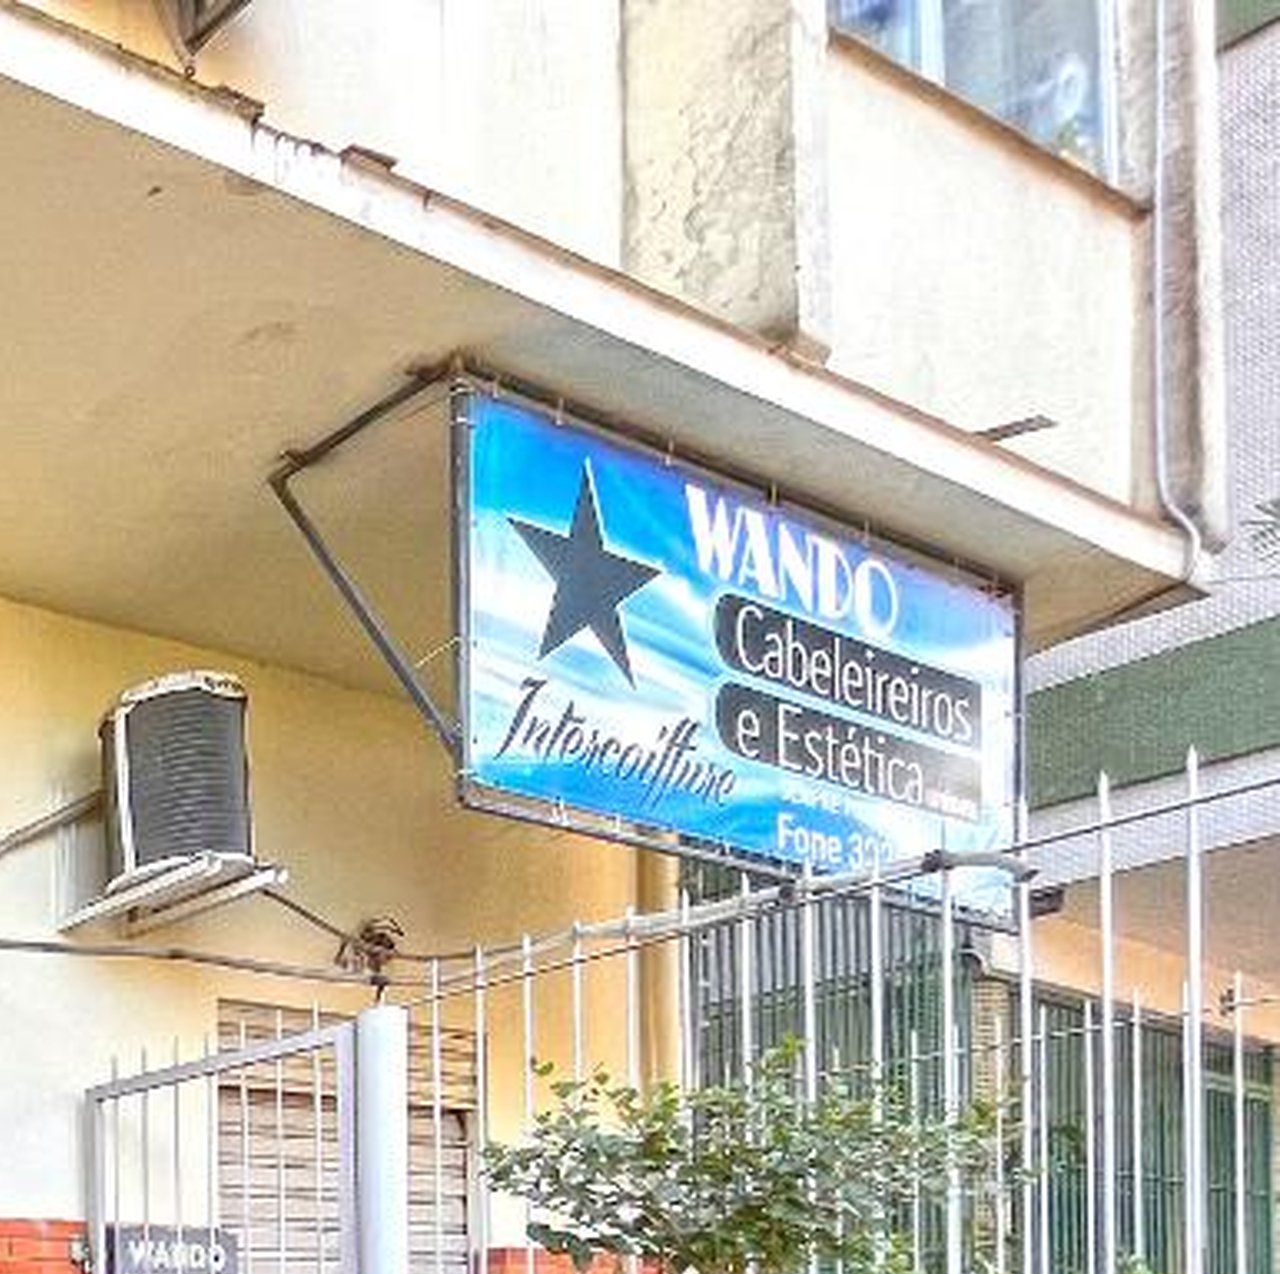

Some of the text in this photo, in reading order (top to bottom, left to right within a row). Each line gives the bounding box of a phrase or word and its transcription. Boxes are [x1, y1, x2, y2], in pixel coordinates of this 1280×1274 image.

[685, 484, 898, 640] WANDO
[736, 604, 973, 742] Cabeleireiros
[736, 708, 761, 758] e
[776, 702, 924, 804] Estética
[777, 812, 842, 863] Fone
